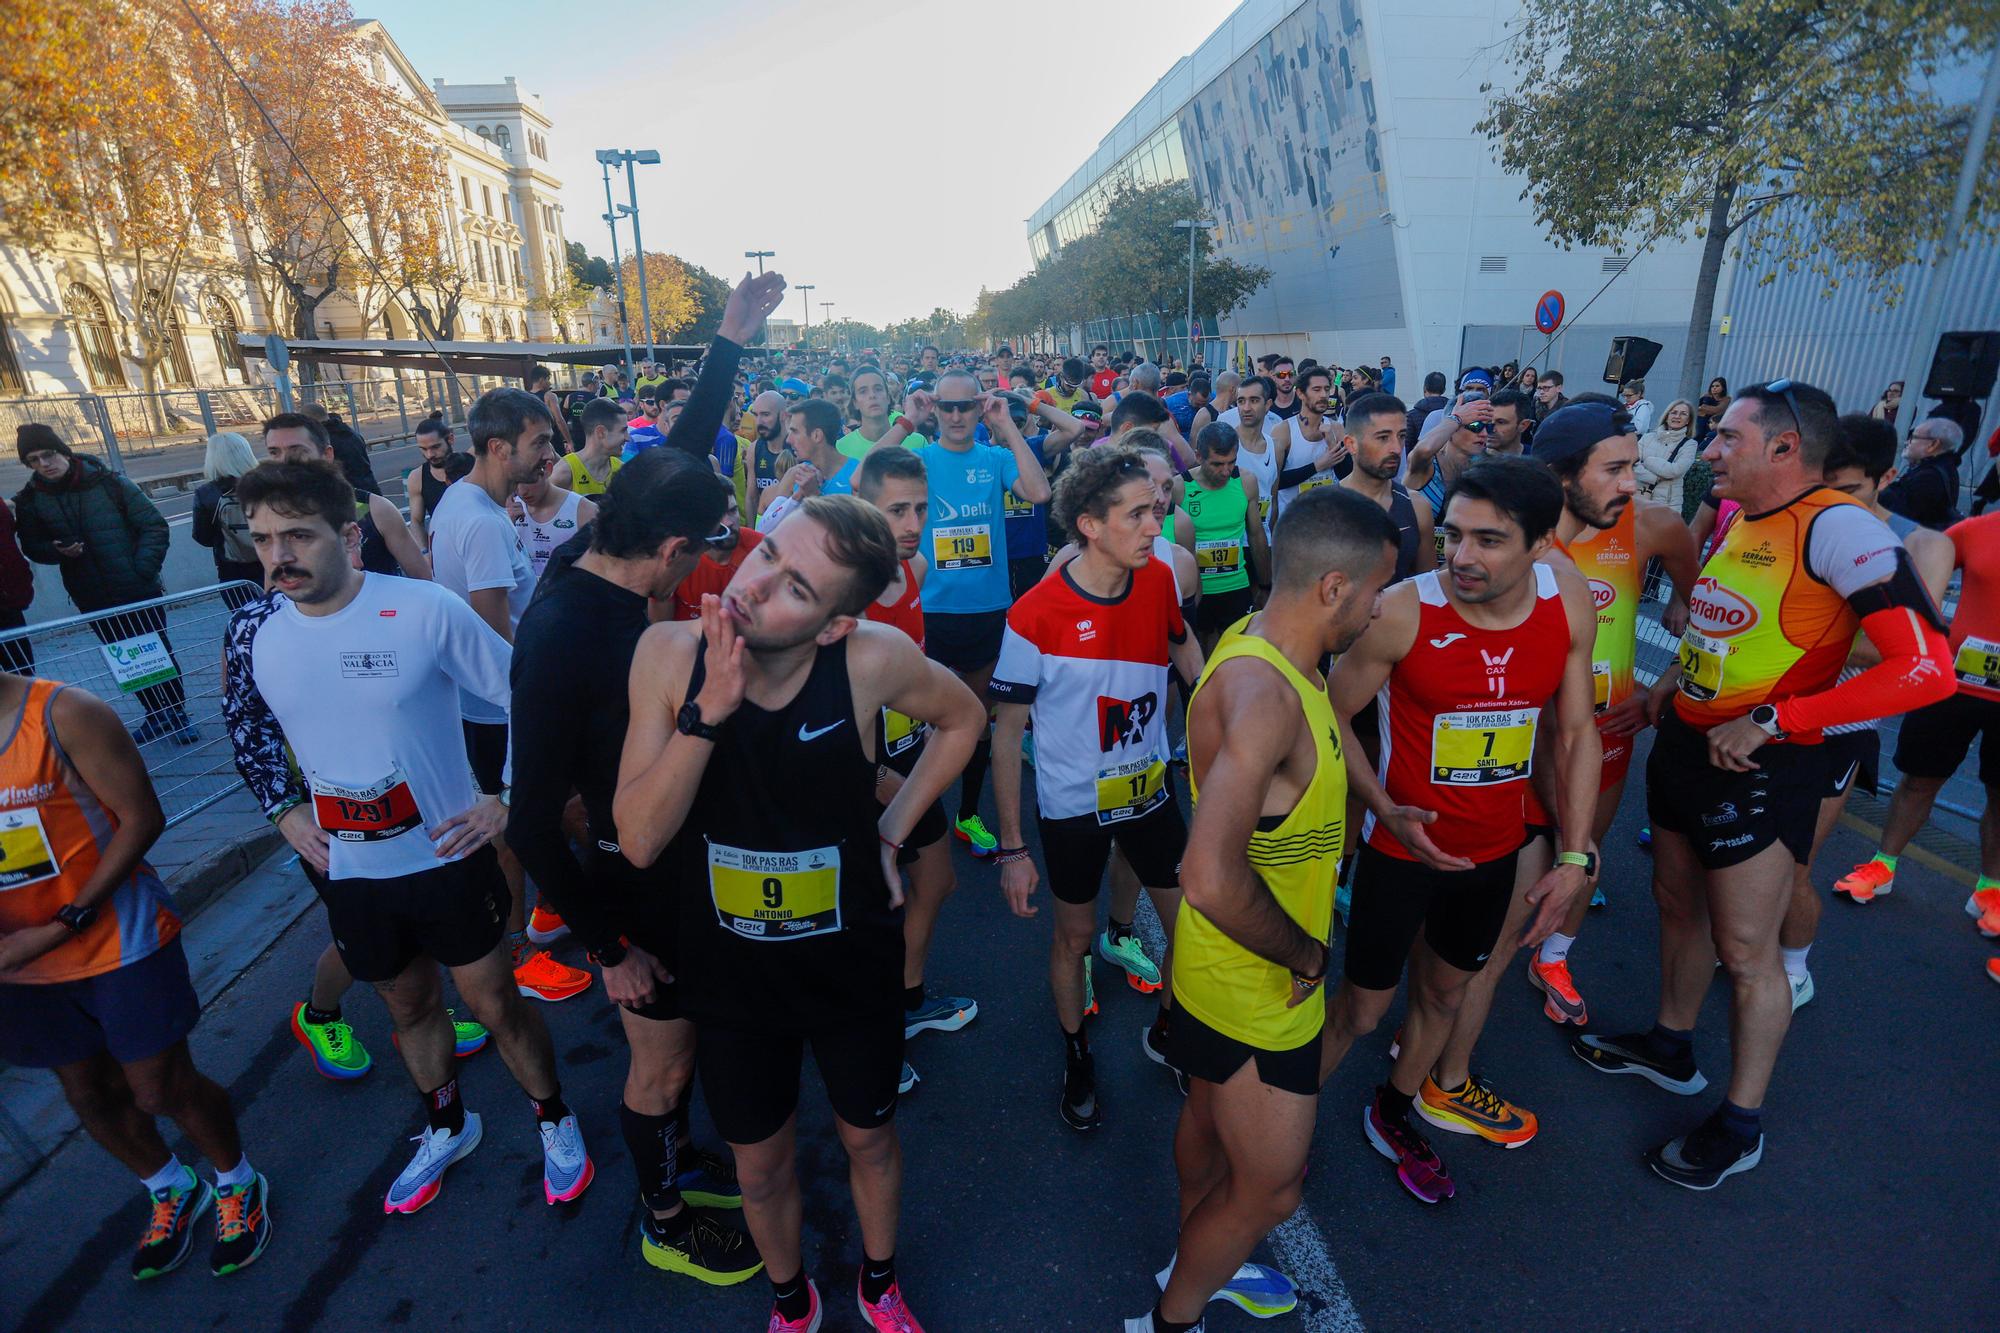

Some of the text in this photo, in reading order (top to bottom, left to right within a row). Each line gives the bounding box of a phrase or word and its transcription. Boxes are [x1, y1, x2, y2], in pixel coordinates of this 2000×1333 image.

[952, 537, 975, 554] 119
[1210, 549, 1229, 562] 137
[1596, 552, 1630, 561] SERRANO
[1741, 551, 1777, 563] SERRANO
[1684, 649, 1700, 674] 21
[1486, 666, 1506, 676] CAX
[989, 680, 1012, 693] PICÓN
[1474, 701, 1507, 709] Atletisme
[1466, 715, 1480, 724] 10K
[1481, 715, 1496, 723] PAS
[1497, 713, 1512, 722] RAS
[1483, 732, 1496, 757] 7
[1477, 759, 1498, 768] SANTI
[1452, 772, 1479, 780] 42K
[1129, 773, 1147, 798] 17
[360, 787, 377, 797] RAS
[336, 796, 392, 822] 1297
[742, 854, 798, 867] 10K PAS RAS
[762, 877, 783, 909] 9
[754, 909, 793, 919] ANTONIO
[735, 921, 762, 932] 42K
